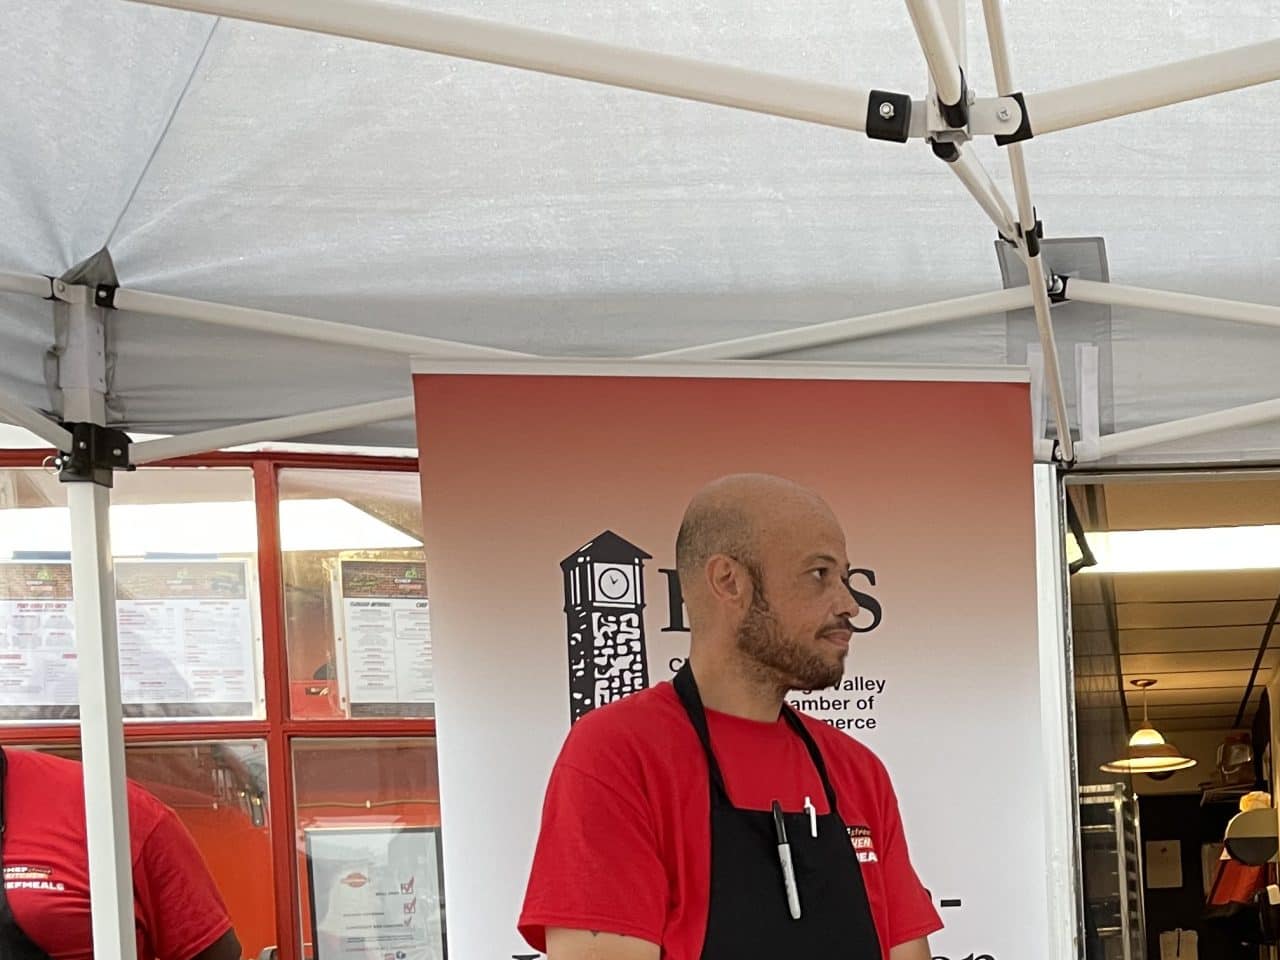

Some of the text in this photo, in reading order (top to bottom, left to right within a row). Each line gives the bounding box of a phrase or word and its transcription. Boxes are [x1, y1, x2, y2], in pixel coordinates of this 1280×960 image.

[790, 695, 875, 711] amber of
[823, 718, 877, 730] erce
[4, 881, 65, 891] EFMEALS
